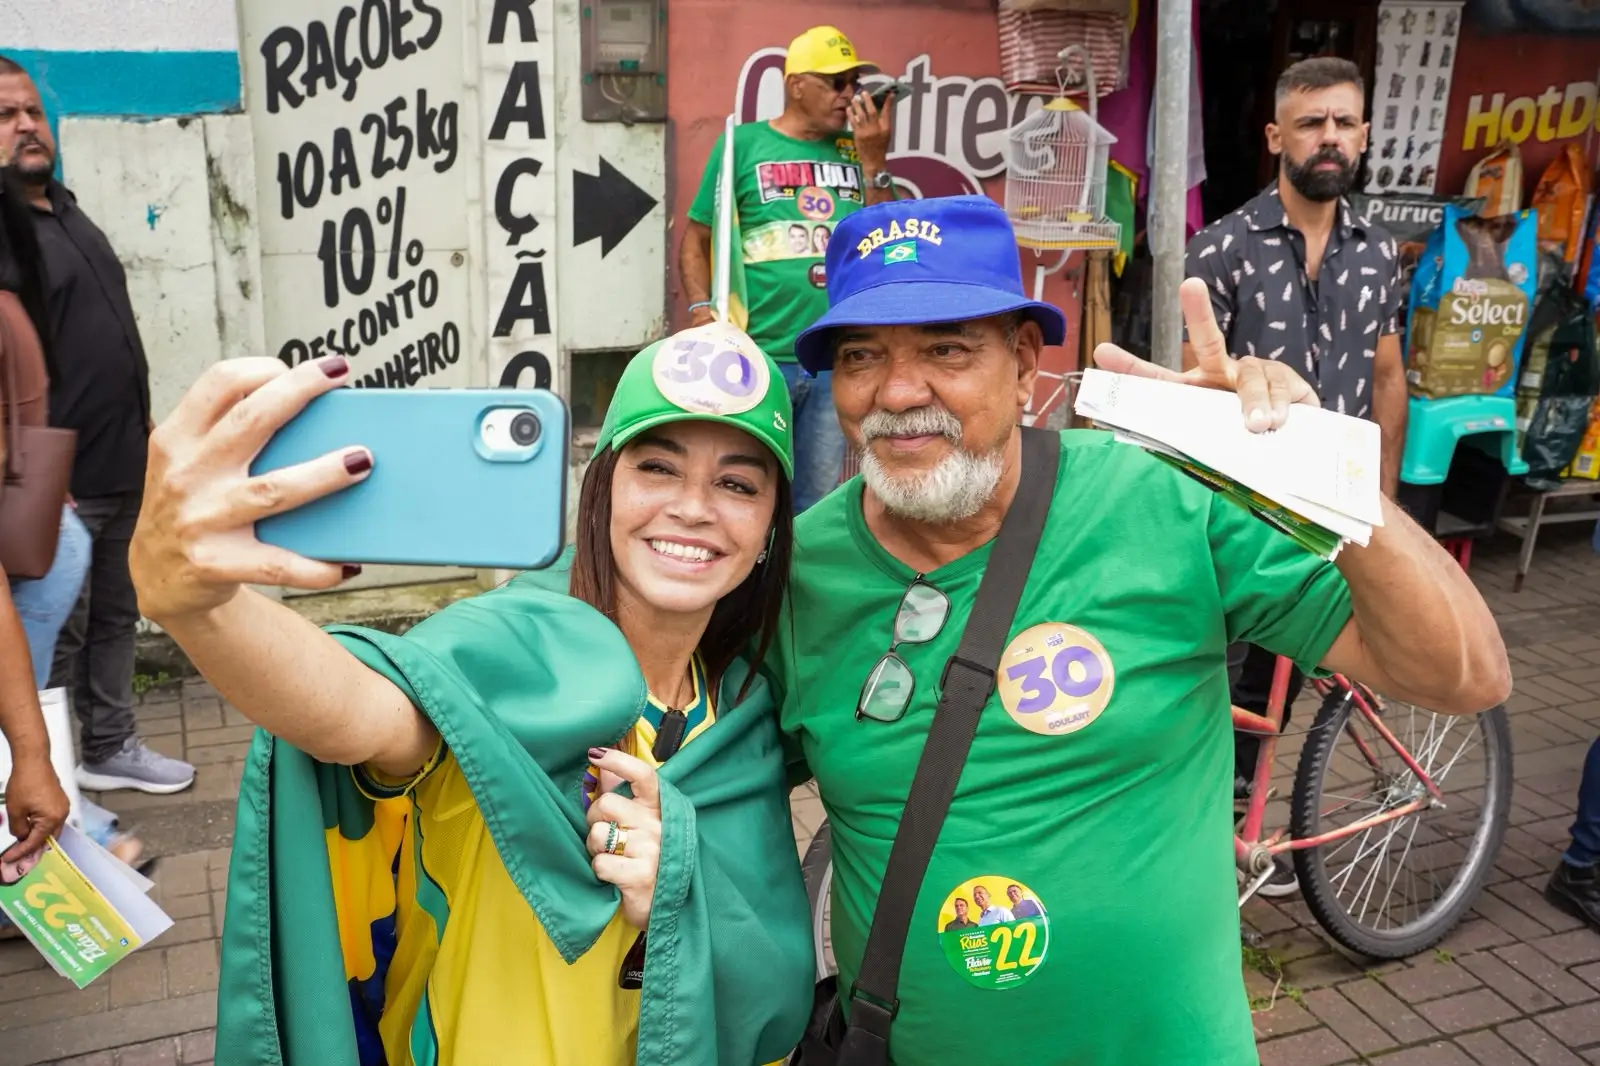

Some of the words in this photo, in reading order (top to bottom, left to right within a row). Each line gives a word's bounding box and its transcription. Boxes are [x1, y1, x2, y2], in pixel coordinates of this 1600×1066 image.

[277, 142, 325, 219] 10
[329, 127, 361, 195] A
[761, 162, 815, 189] FORA
[814, 163, 859, 190] LULA
[801, 194, 832, 214] 30
[317, 186, 424, 308] 10%
[857, 218, 943, 259] BRASIL
[1451, 297, 1524, 325] Select
[660, 340, 757, 398] 30
[1006, 646, 1104, 714] 30
[1048, 711, 1091, 730] GOULART
[24, 871, 88, 928] 22
[960, 936, 988, 950] Ruas
[991, 922, 1042, 971] 22
